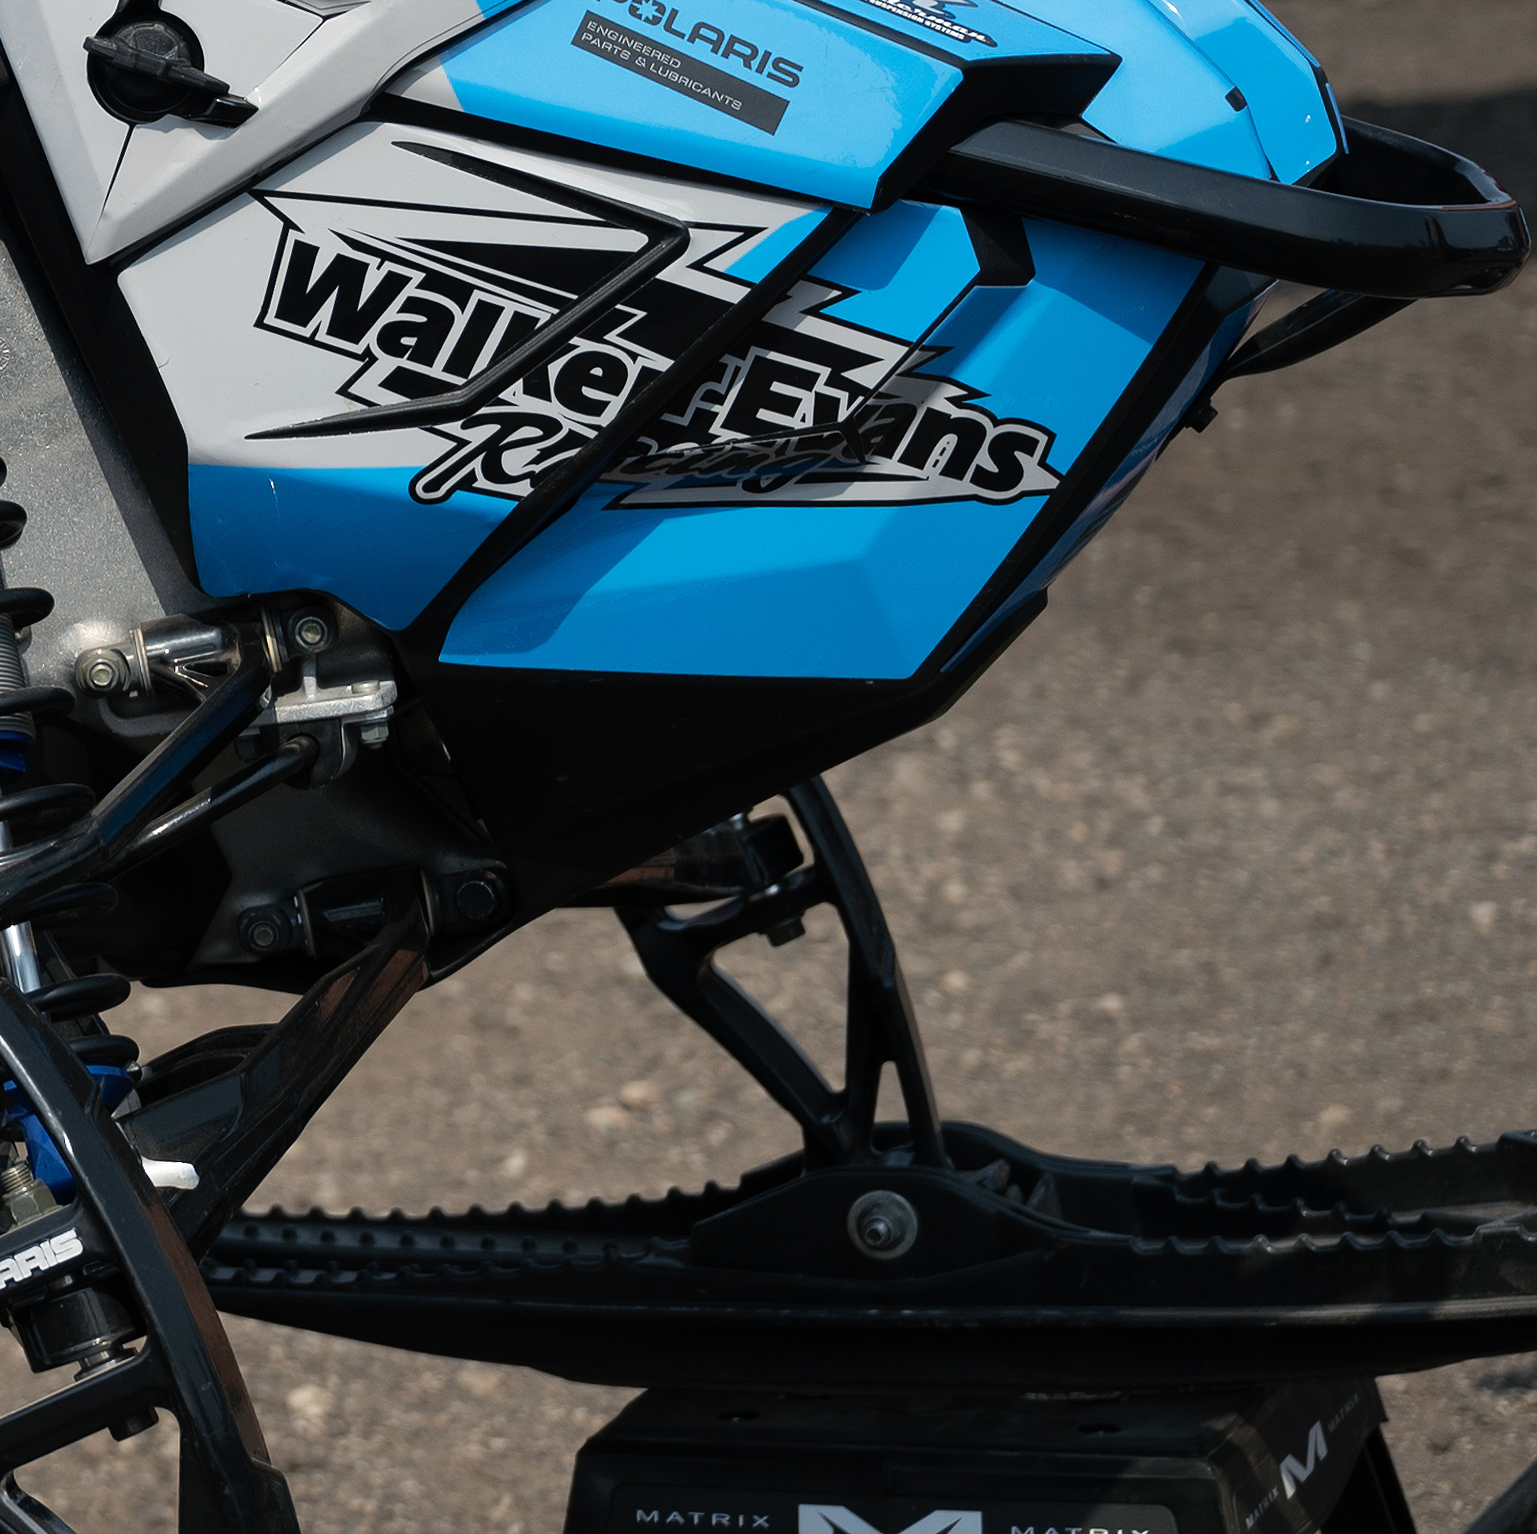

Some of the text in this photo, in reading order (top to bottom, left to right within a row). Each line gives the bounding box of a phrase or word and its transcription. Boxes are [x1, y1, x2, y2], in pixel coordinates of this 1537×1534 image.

[586, 20, 682, 68] ENGINEERED
[924, 20, 966, 40] SYSTEMS
[581, 32, 743, 111] PARTS & LUBRICANTS
[634, 1508, 770, 1529] MATRIX
